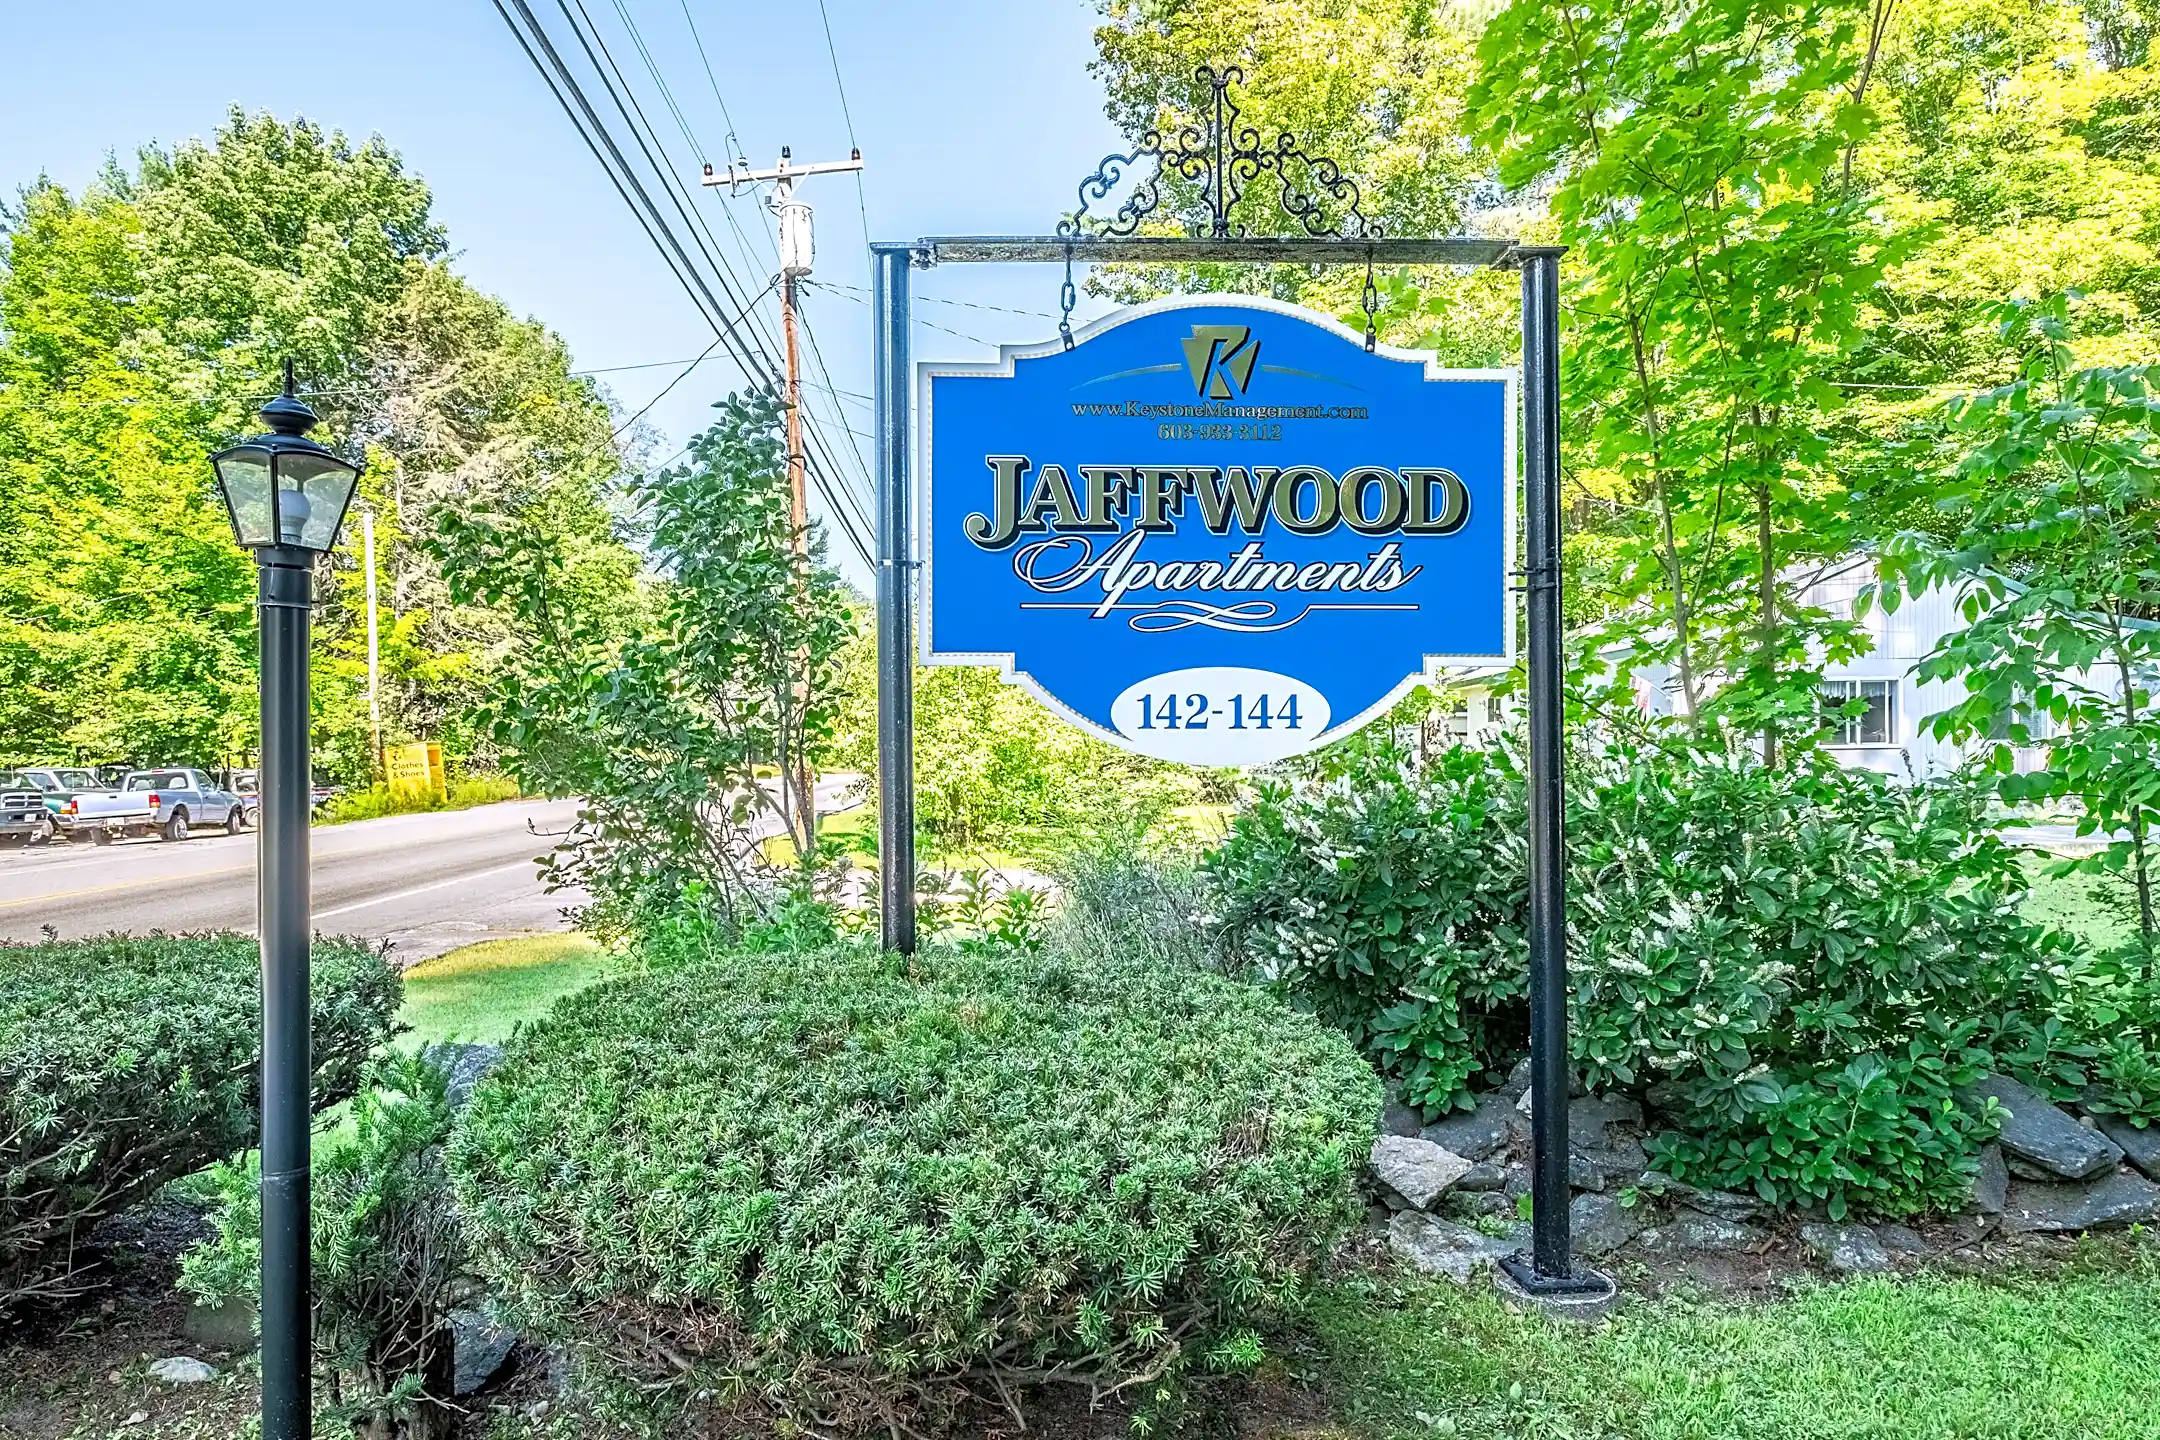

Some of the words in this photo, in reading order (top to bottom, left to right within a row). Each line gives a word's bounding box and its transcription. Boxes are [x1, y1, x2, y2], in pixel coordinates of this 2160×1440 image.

[1071, 400, 1369, 420] www.KeystoneManagement.com
[1157, 423, 1282, 441] 603-933-3112
[962, 454, 1473, 552] JAFFWOOD
[1012, 528, 1423, 619] Apartments
[1136, 693, 1303, 730] 142-144
[391, 762, 424, 770] Clothes
[400, 770, 425, 778] Shoes
